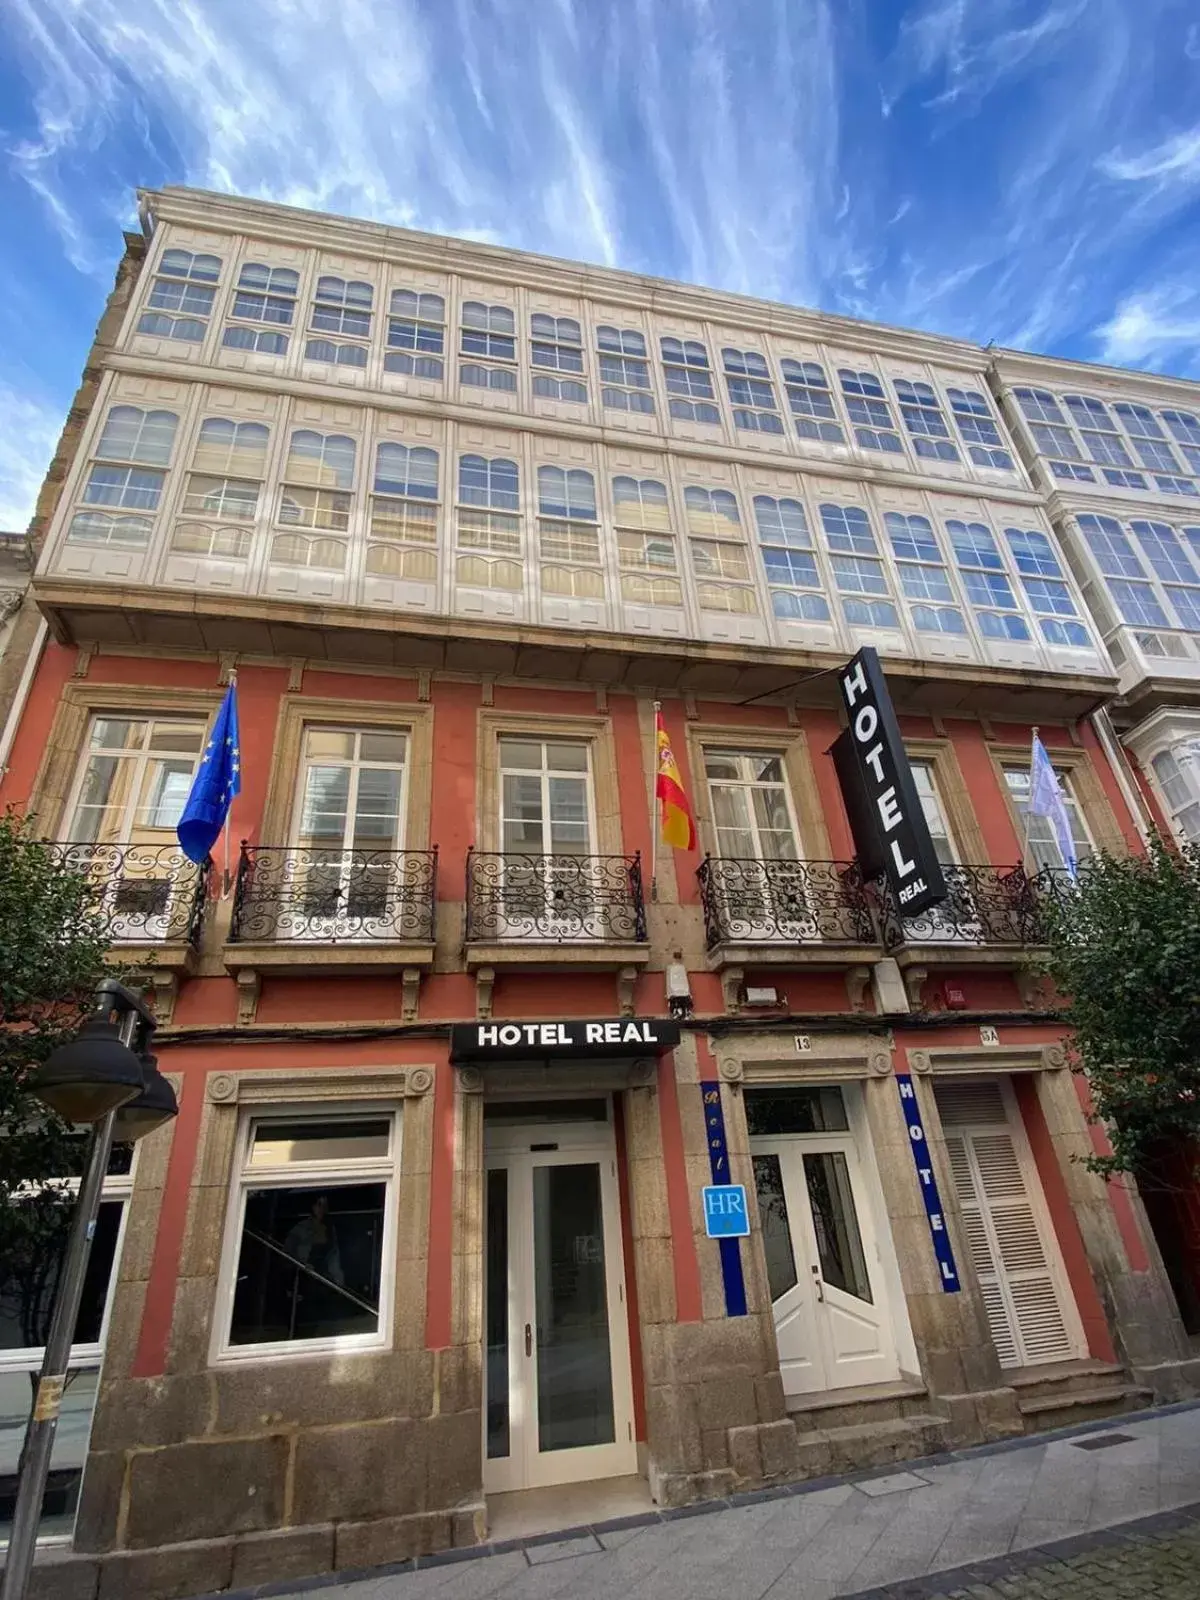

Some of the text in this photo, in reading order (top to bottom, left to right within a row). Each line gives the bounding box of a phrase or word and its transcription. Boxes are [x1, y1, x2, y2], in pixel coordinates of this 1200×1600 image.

[843, 661, 916, 879] HOTEL
[899, 877, 928, 905] REAL
[478, 1022, 658, 1047] HOTEL REAL
[796, 1037, 811, 1050] 13
[704, 1090, 724, 1171] Real
[899, 1083, 955, 1280] HOTEL
[707, 1191, 744, 1216] HR
